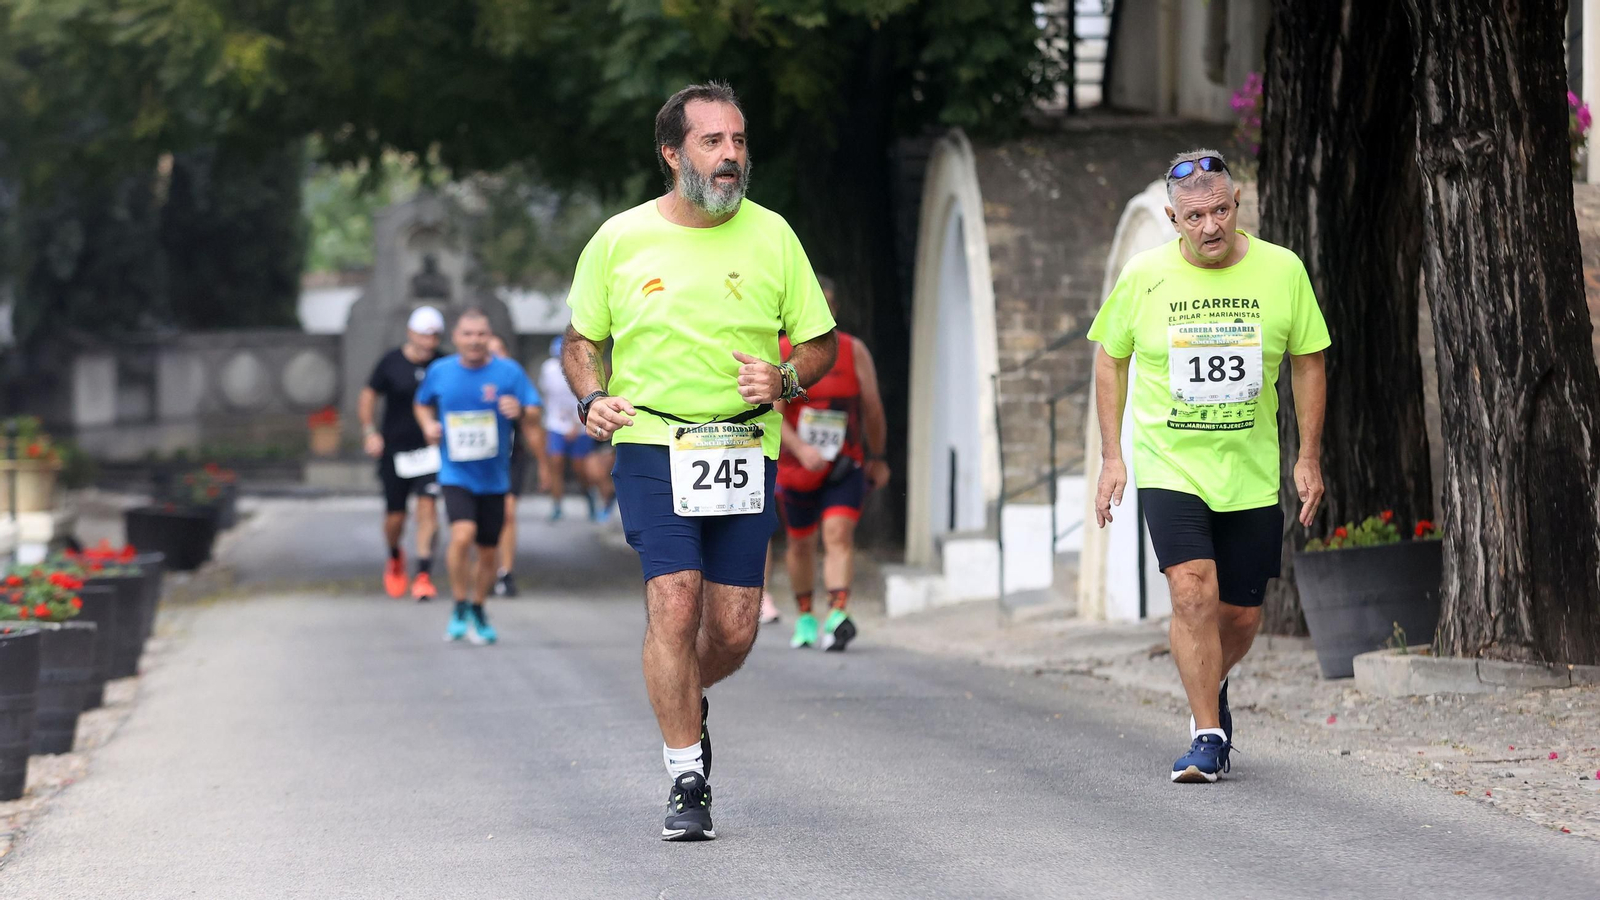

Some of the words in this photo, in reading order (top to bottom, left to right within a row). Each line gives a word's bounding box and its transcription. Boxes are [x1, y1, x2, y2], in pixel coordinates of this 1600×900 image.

[1169, 301, 1187, 312] VII
[1192, 298, 1260, 310] CARRERA
[1179, 313, 1201, 321] PILAR
[1209, 311, 1260, 319] MARIANISTAS
[1188, 355, 1246, 382] 183
[692, 458, 749, 490] 245
